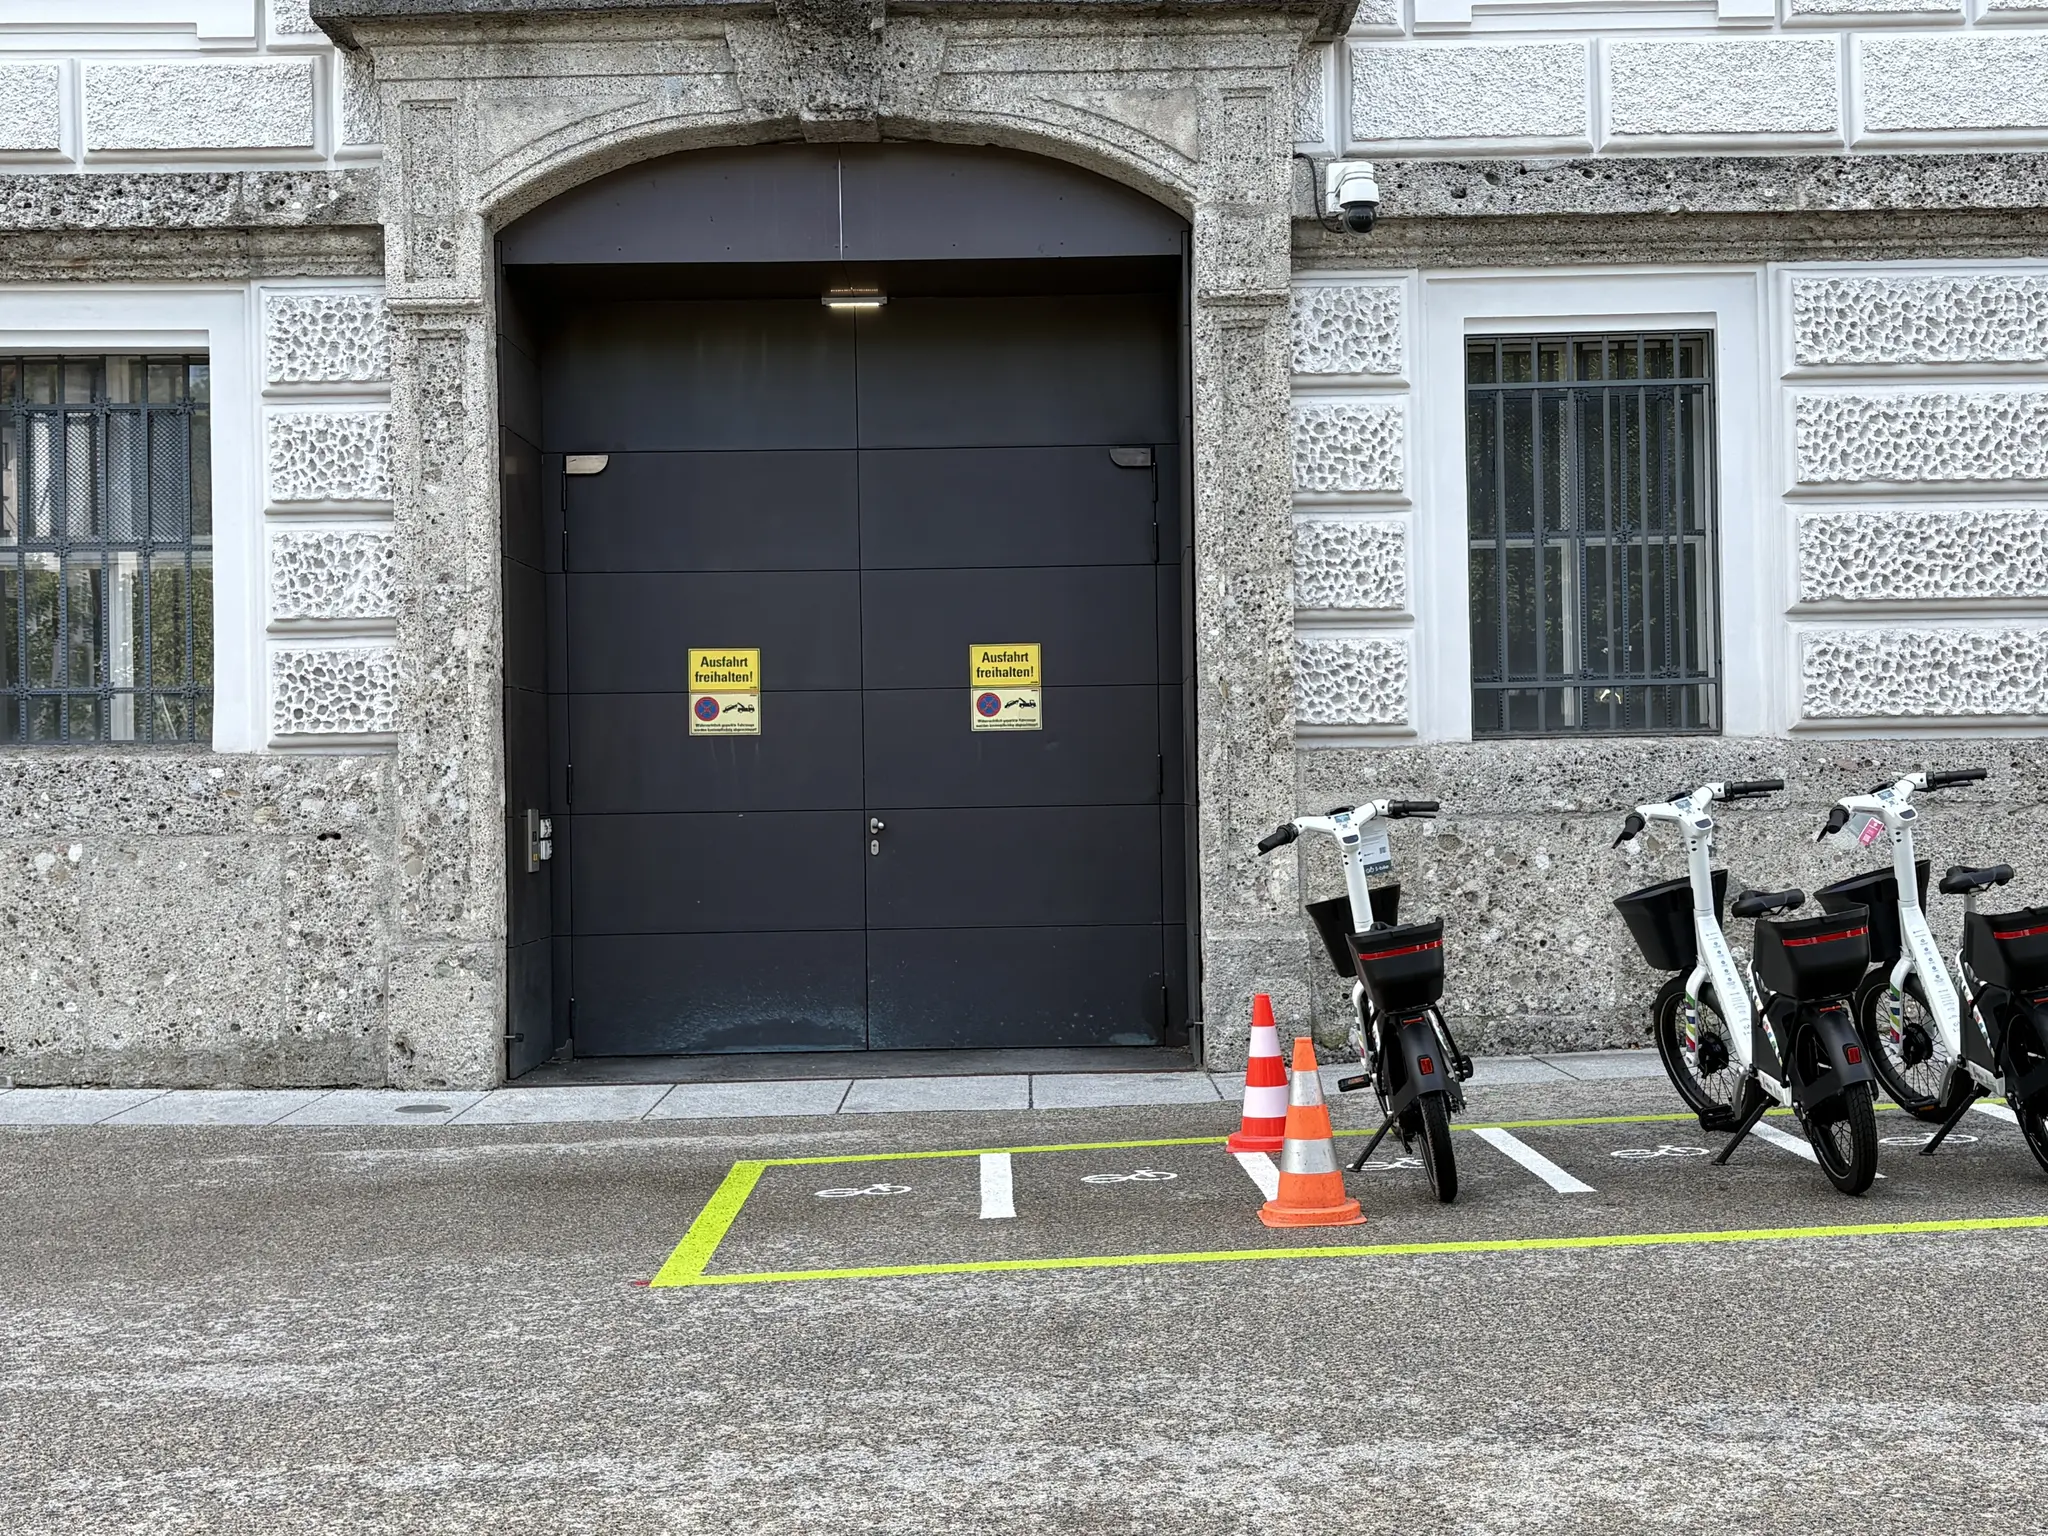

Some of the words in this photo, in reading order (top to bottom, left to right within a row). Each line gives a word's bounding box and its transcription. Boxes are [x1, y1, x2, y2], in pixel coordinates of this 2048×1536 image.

[700, 656, 748, 667] Ausfahrt
[982, 651, 1029, 663] Ausfahrt
[695, 671, 753, 682] freihalten!
[976, 666, 1034, 678] freihalten!
